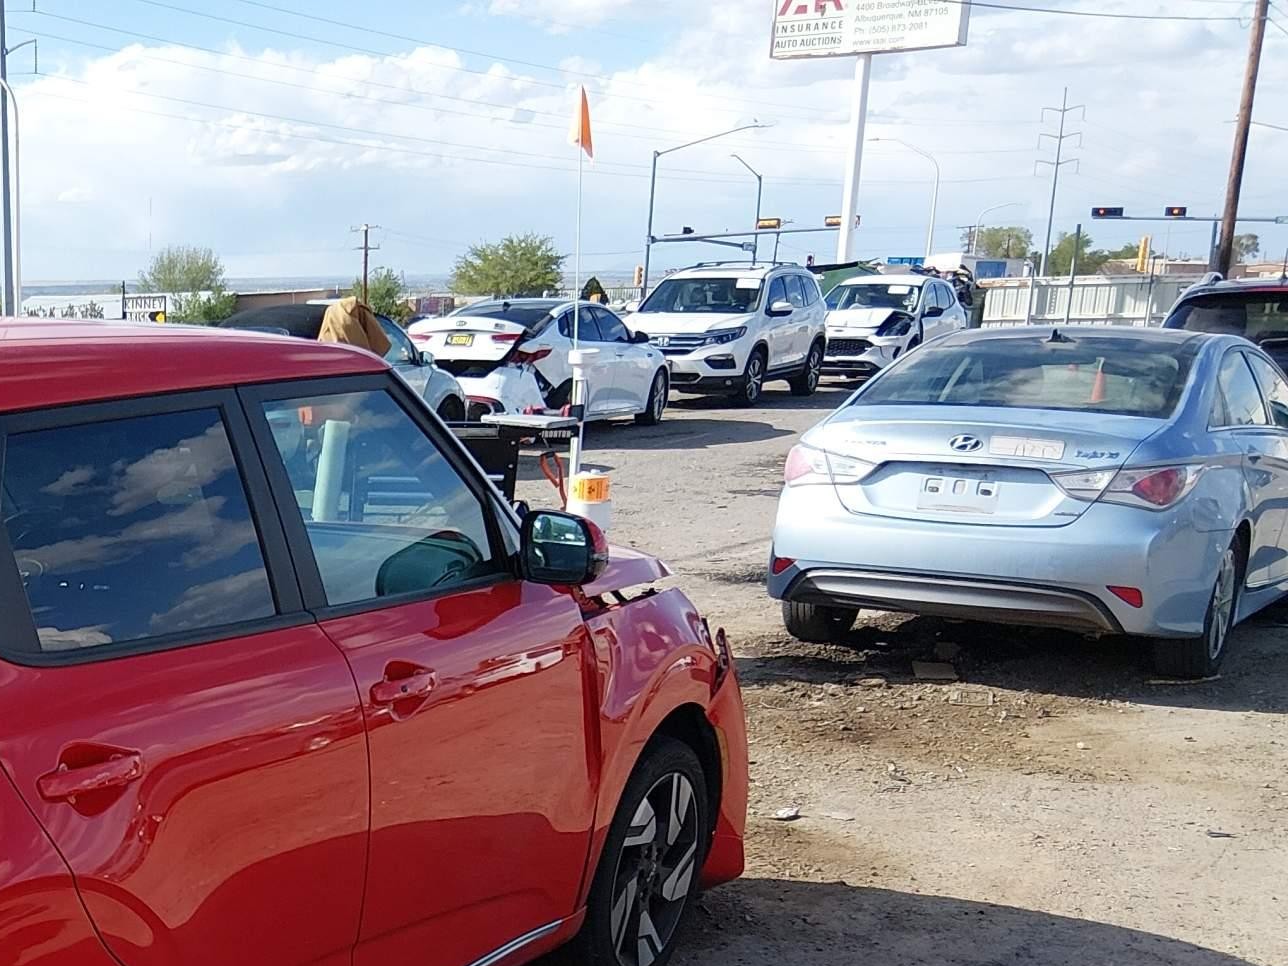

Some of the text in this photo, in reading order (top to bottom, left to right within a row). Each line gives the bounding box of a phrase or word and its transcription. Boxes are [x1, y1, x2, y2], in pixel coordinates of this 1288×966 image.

[776, 20, 843, 34] INSURANCE
[775, 36, 842, 49] AUTO AUCTIONS
[124, 298, 163, 310] KINNEY
